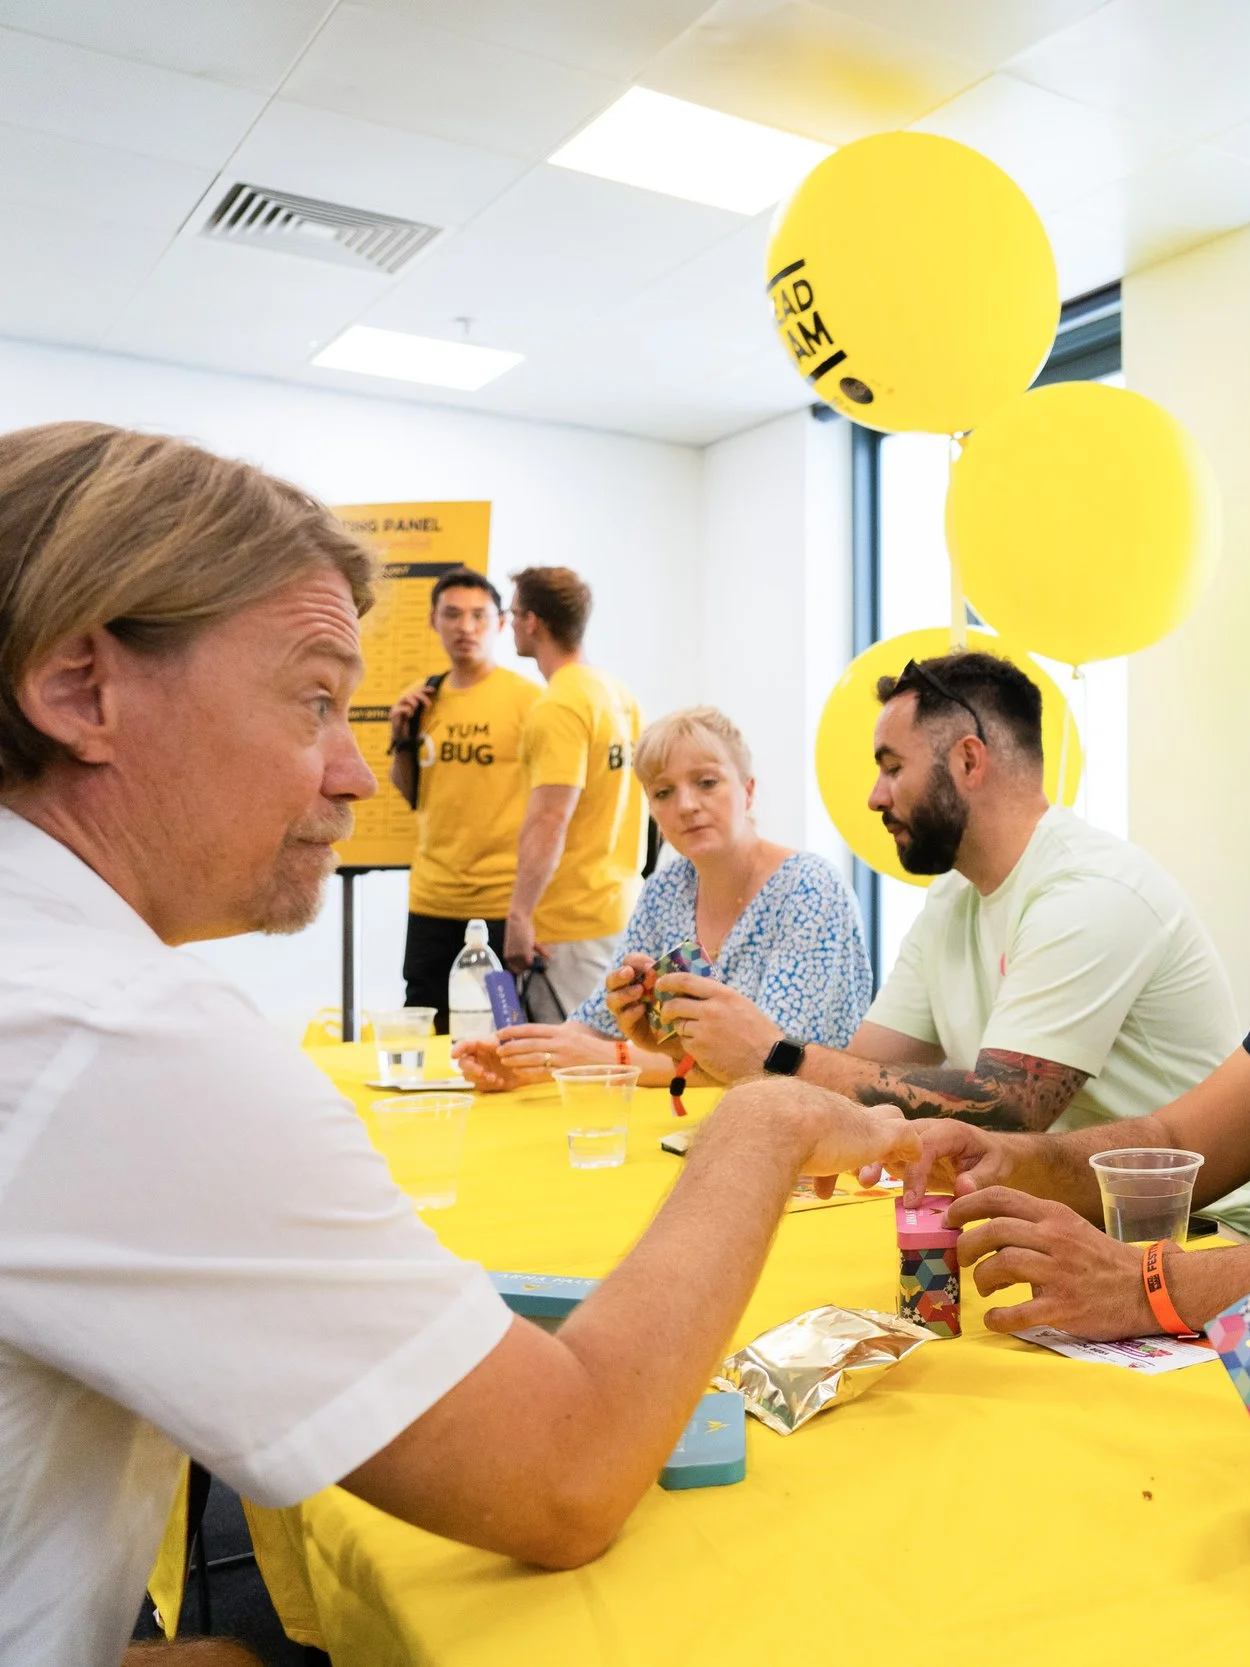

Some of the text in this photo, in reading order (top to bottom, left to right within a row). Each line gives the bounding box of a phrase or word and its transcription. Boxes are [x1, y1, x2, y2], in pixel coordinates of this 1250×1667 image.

[787, 310, 835, 362] AM
[383, 518, 443, 533] PANEL
[447, 722, 490, 739] YUM
[440, 741, 495, 766] BUG
